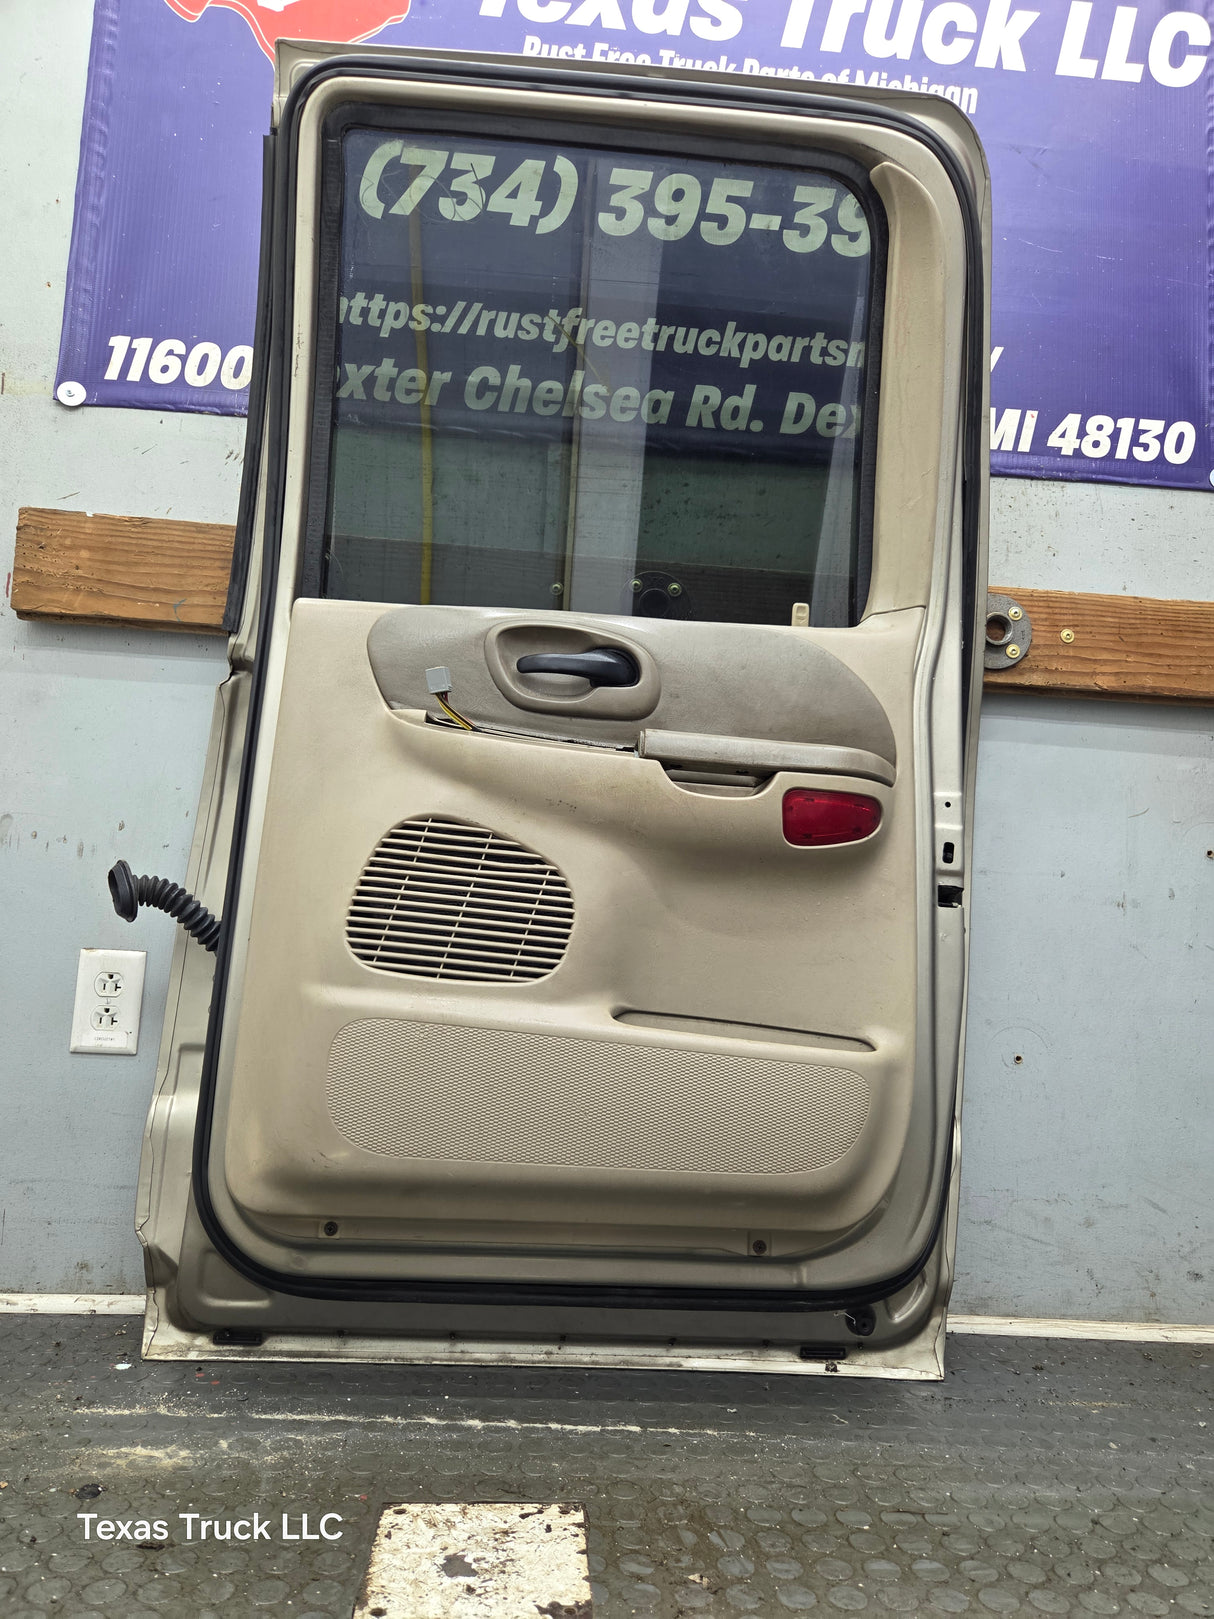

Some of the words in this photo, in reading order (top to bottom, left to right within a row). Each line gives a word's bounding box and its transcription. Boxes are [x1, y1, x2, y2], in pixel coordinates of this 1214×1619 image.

[780, 0, 1041, 72] Truck
[1055, 0, 1212, 88] LLC
[359, 140, 579, 235] (734)
[597, 167, 871, 258] 395-39
[103, 335, 254, 390] 11600
[336, 358, 452, 406] xter
[463, 365, 675, 424] Chelsea
[685, 384, 764, 432] Rd.
[990, 407, 1039, 453] MI
[1046, 413, 1197, 465] 48130
